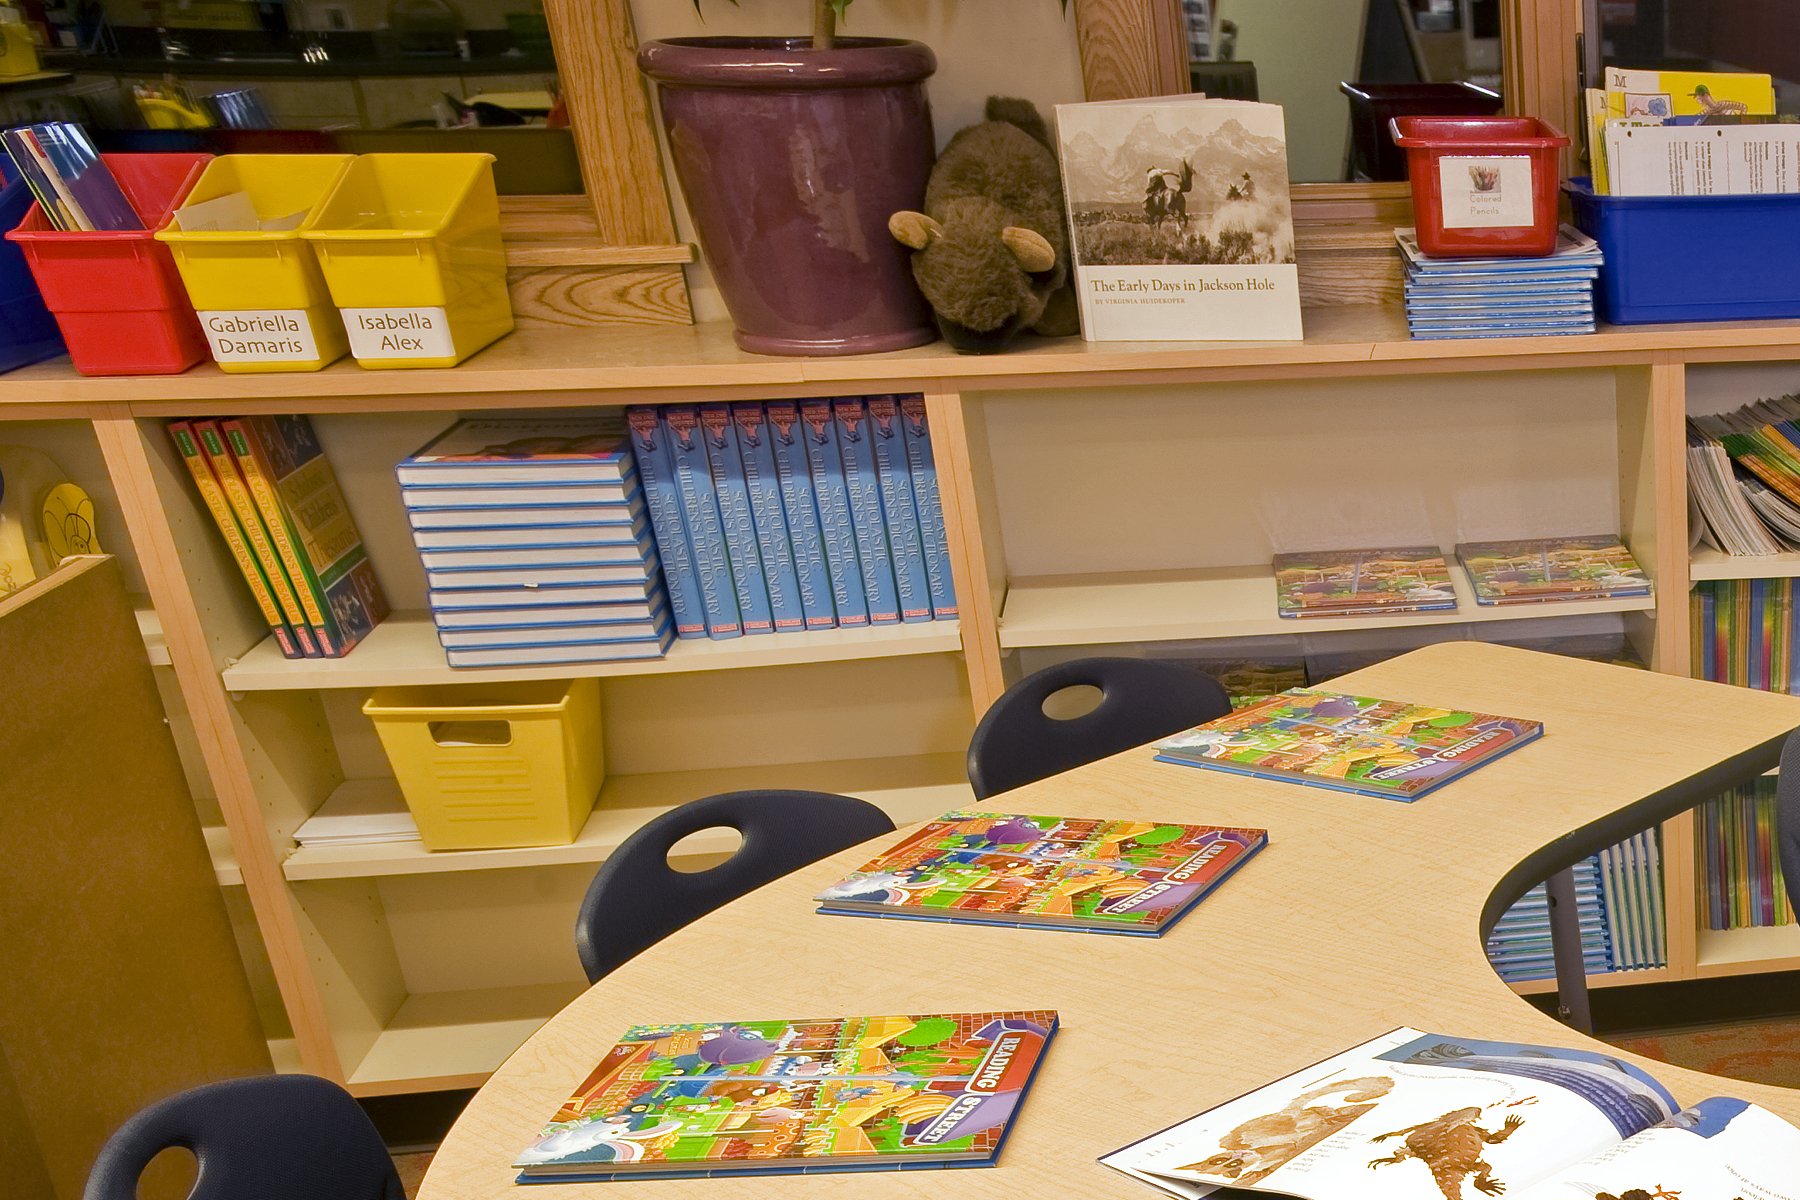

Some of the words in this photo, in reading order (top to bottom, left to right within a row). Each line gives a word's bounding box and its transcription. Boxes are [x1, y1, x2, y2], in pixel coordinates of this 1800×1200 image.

[1613, 74, 1626, 88] M
[1470, 194, 1502, 203] Colored
[1470, 206, 1500, 215] Pencils
[209, 314, 300, 333] Gabriella
[358, 312, 433, 331] Isabella
[1090, 279, 1115, 292] The
[1118, 279, 1149, 294] Early
[1152, 279, 1181, 293] Days
[1184, 278, 1196, 291] in
[1199, 278, 1244, 293] Jackson
[1247, 278, 1275, 291] Hole
[217, 337, 303, 355] Damaris
[381, 334, 425, 351] Alex
[191, 458, 228, 518] SCHOLASTIC
[247, 570, 280, 623] THESAURUS
[217, 457, 253, 517] SCHOLASTIC
[270, 570, 302, 623] THESAURUS
[244, 458, 275, 518] SCHOLASTIC
[291, 570, 322, 623] THESAURUS
[640, 455, 665, 532] CHILDREN'S
[657, 536, 688, 616] DICTIONARY
[665, 493, 692, 578] SCHOLASTIC
[677, 455, 700, 532] CHILDREN'S
[694, 536, 722, 616] DICTIONARY
[701, 493, 727, 578] SCHOLASTIC
[711, 452, 734, 529] CHILDREN'S
[727, 533, 753, 612] DICTIONARY
[734, 491, 760, 575] SCHOLASTIC
[742, 451, 766, 528] CHILDREN'S
[760, 531, 785, 611] DICTIONARY
[767, 489, 792, 573] SCHOLASTIC
[776, 449, 800, 527] CHILDREN'S
[792, 529, 817, 608] DICTIONARY
[798, 487, 824, 572] SCHOLASTIC
[811, 448, 833, 525] CHILDREN'S
[825, 529, 850, 608] DICTIONARY
[832, 486, 857, 570] SCHOLASTIC
[844, 446, 866, 522] CHILDREN'S
[857, 525, 881, 604] DICTIONARY
[864, 483, 888, 568] SCHOLASTIC
[876, 443, 900, 520] CHILDREN'S
[889, 521, 914, 600] DICTIONARY
[897, 480, 921, 564] SCHOLASTIC
[908, 441, 932, 519] CHILDREN'S
[922, 519, 946, 598] DICTIONARY
[1373, 757, 1437, 780] STREET
[1445, 729, 1500, 761] READING
[1111, 883, 1172, 914] STREET
[1174, 844, 1228, 881] READING
[976, 1037, 1022, 1089] READING
[924, 1096, 982, 1142] STREET
[1751, 1183, 1772, 1196] ways
